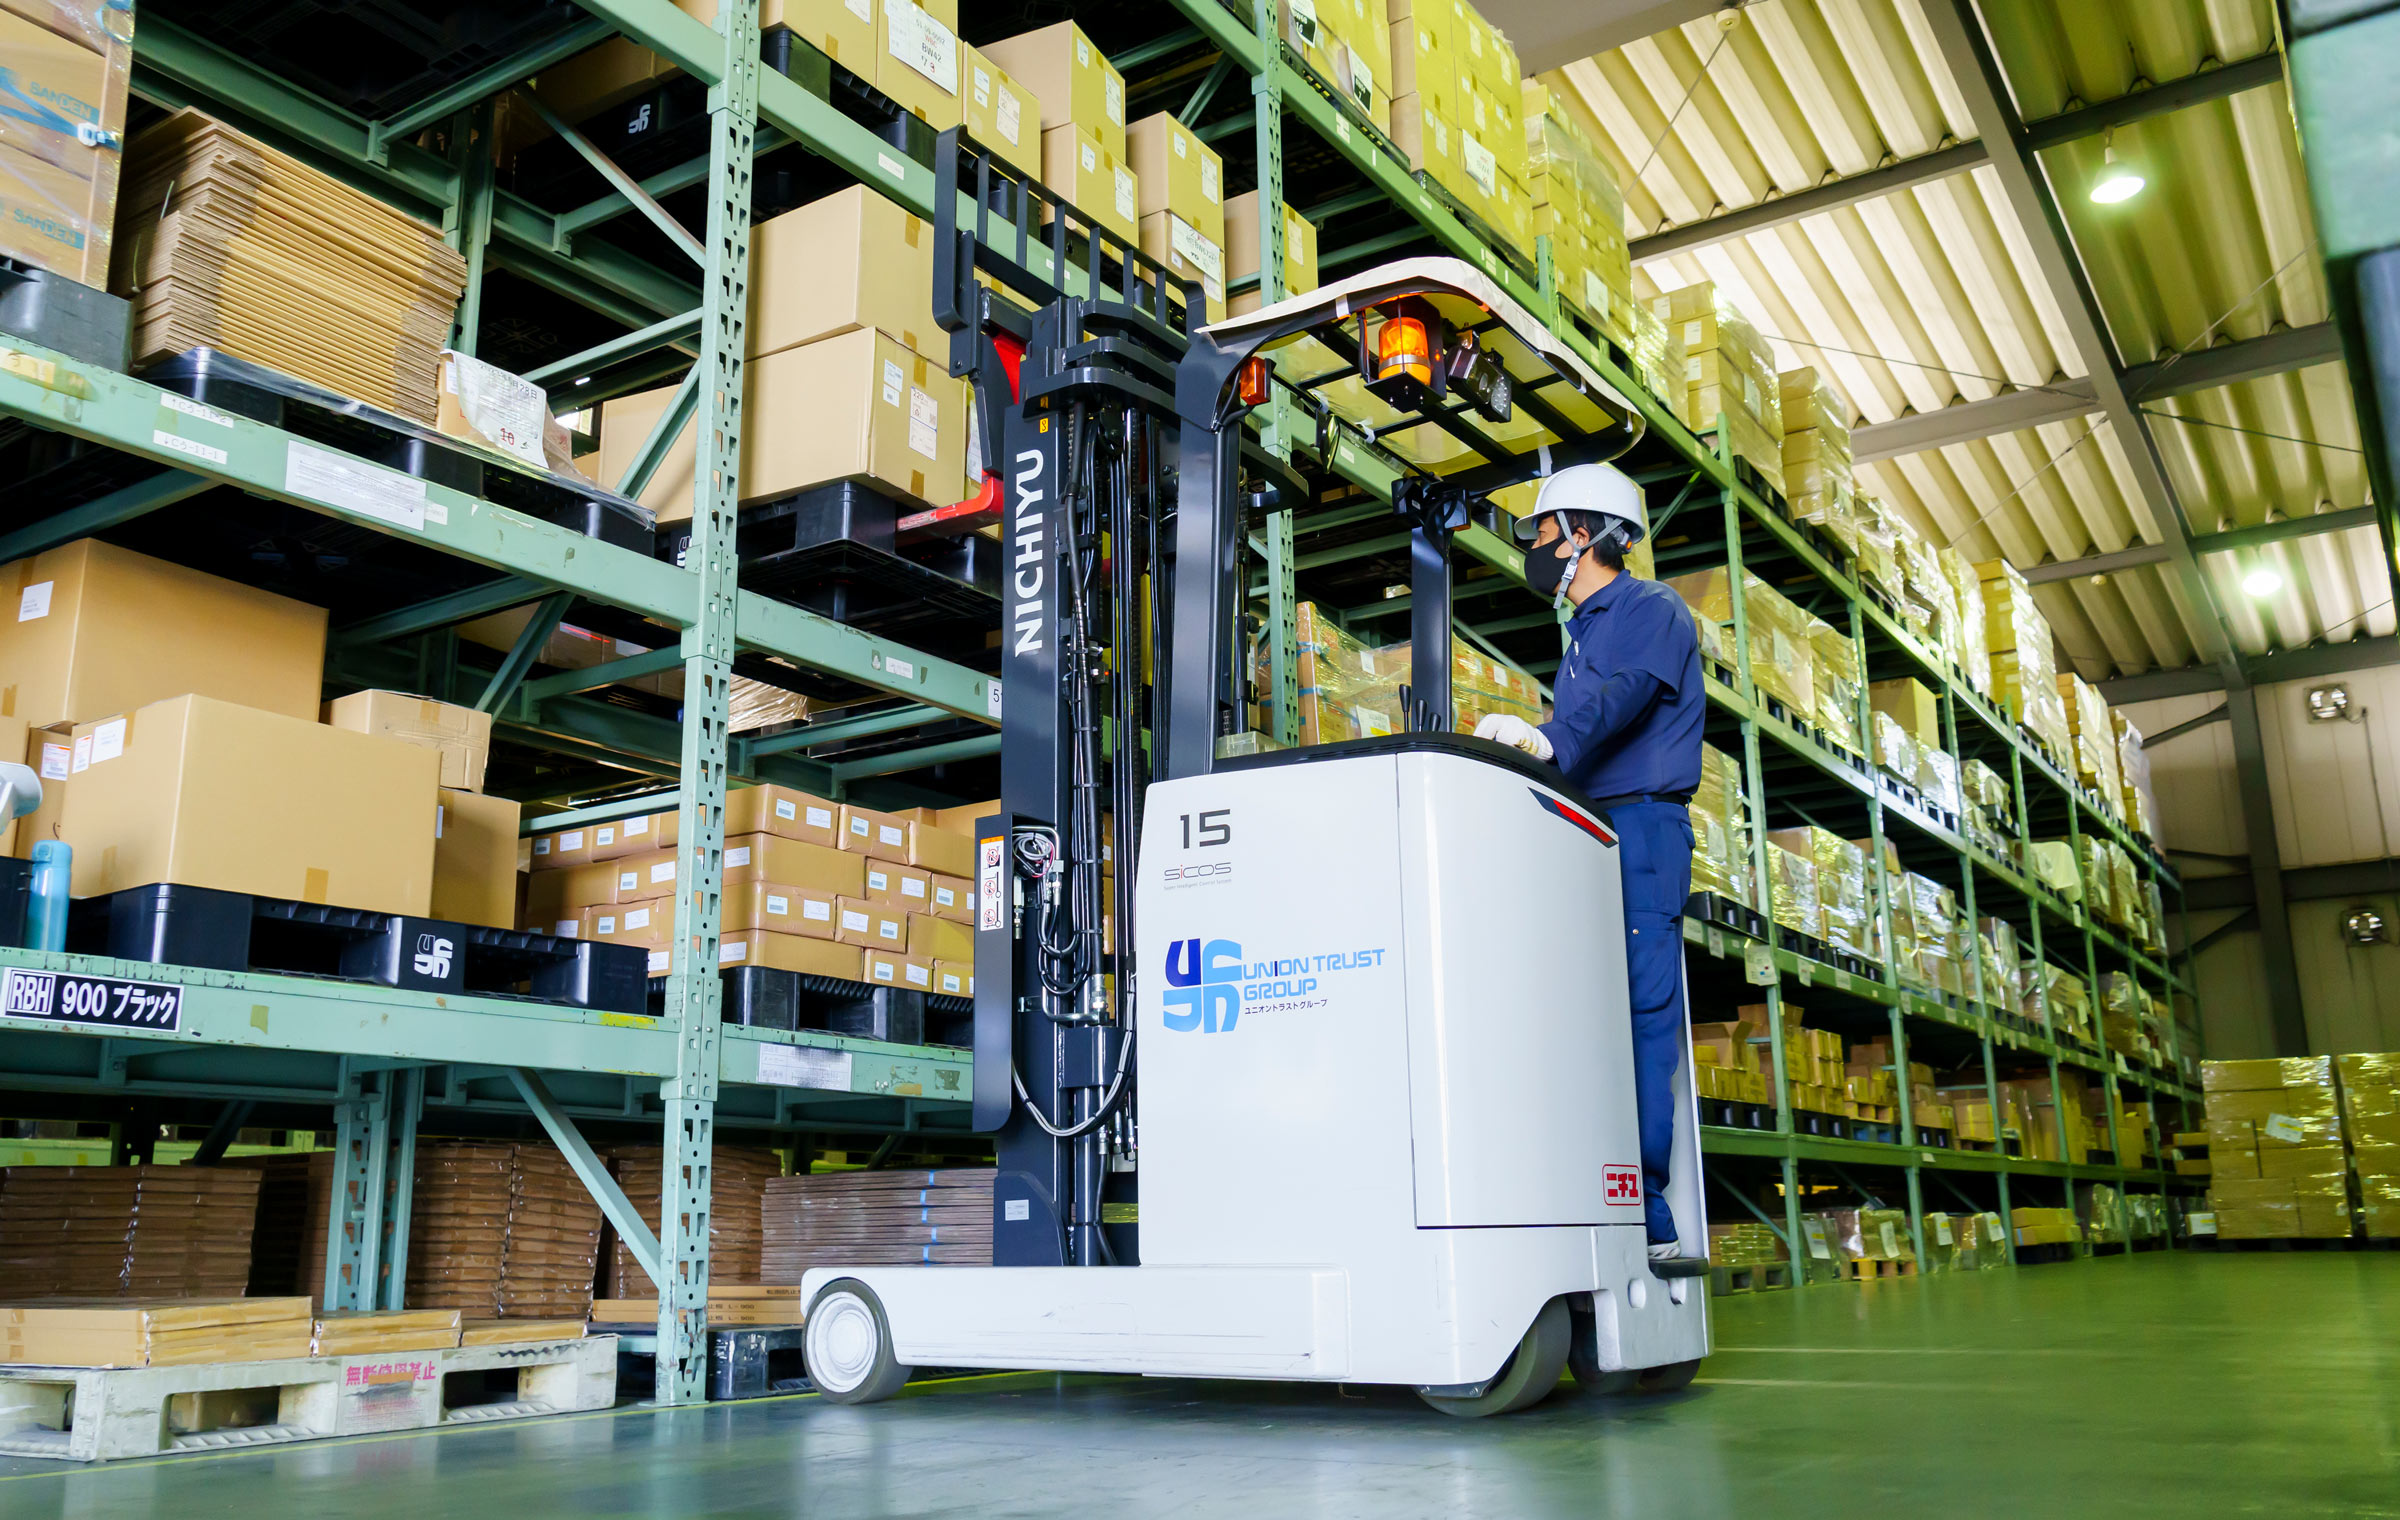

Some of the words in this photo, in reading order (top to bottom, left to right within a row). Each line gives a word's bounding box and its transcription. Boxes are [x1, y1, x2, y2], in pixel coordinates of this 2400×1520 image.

[29, 81, 92, 119] SANDEN
[13, 208, 77, 246] SANDEN
[1014, 449, 1044, 658] NICHIYU
[1180, 808, 1231, 849] 15
[1243, 957, 1310, 980] UNION
[1313, 948, 1386, 973] TRUST
[10, 974, 52, 1012] RBH
[62, 980, 108, 1018] 900
[113, 984, 176, 1024] ブラック
[1243, 977, 1318, 1001] GROUP
[1244, 998, 1328, 1015] ユニオントラストグループ
